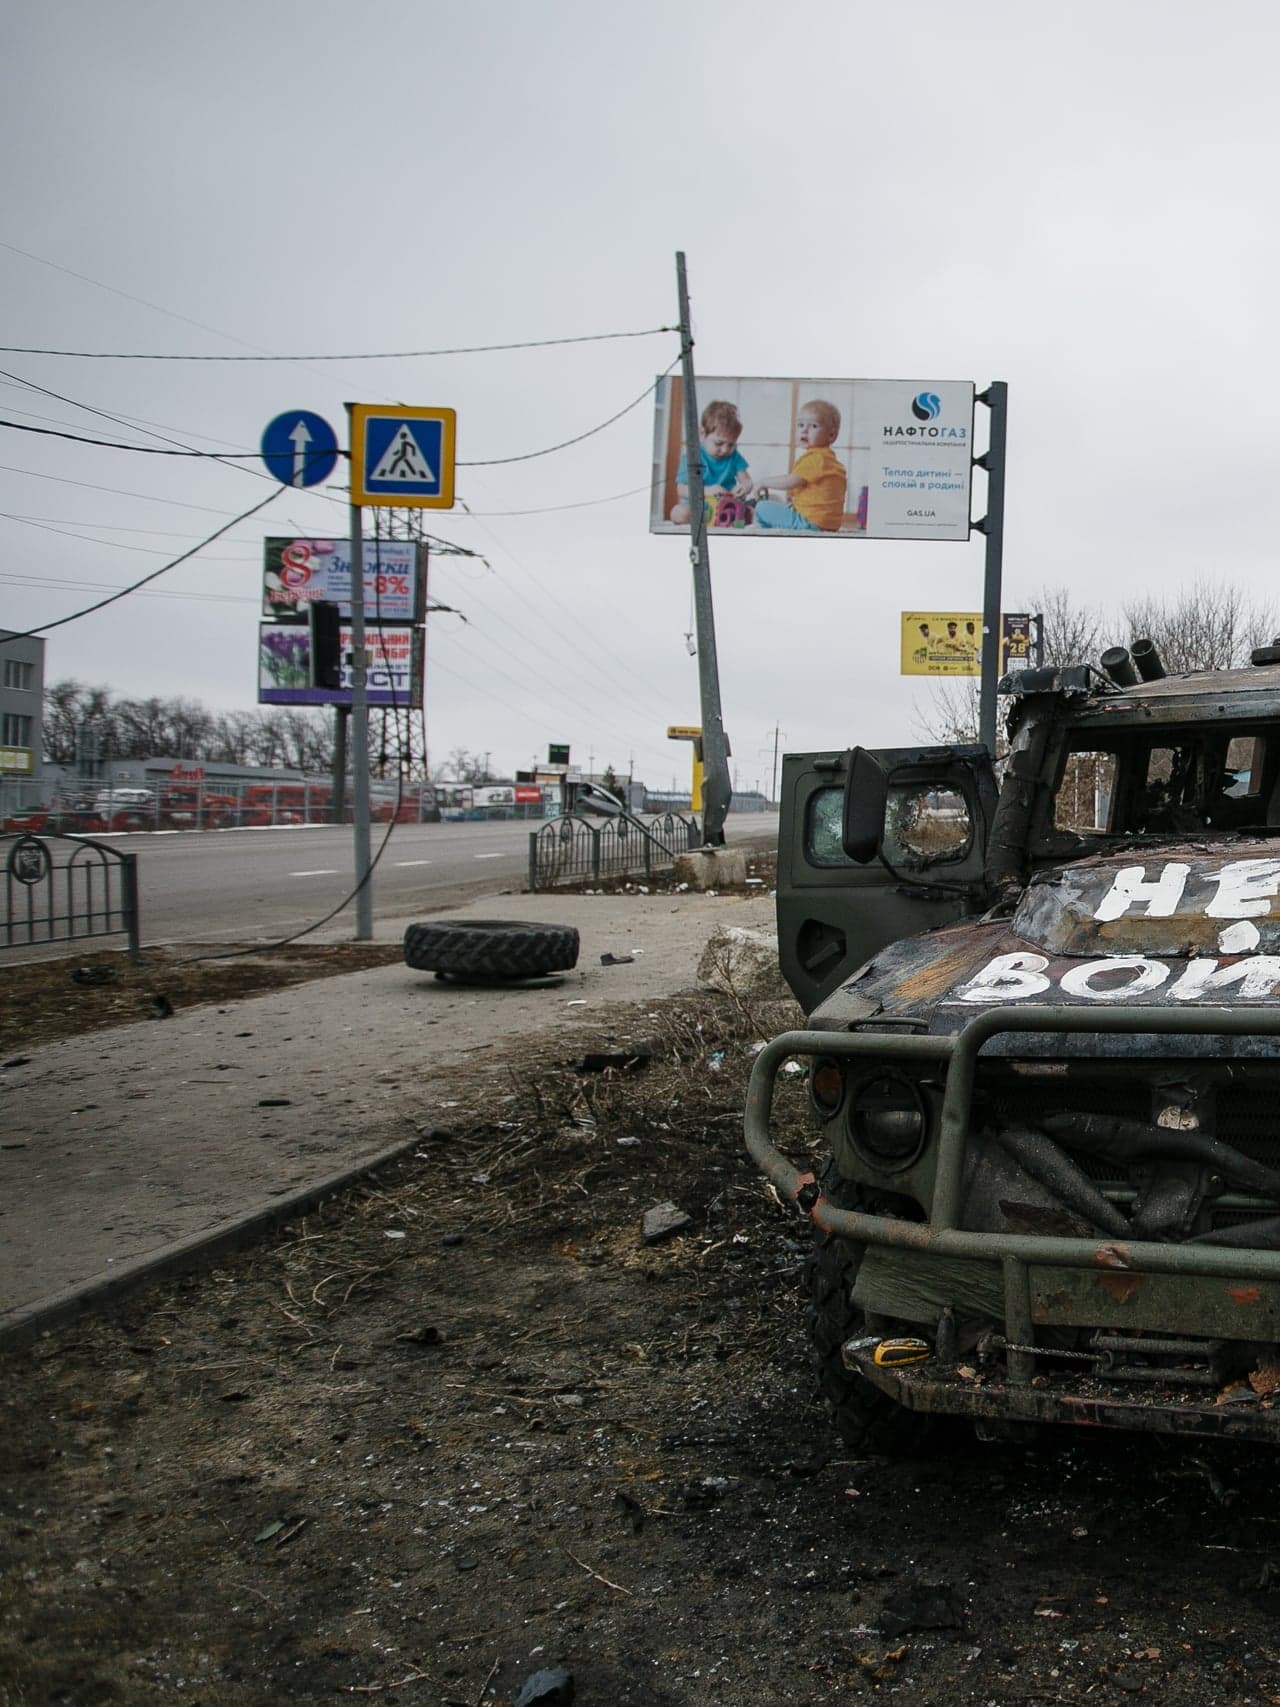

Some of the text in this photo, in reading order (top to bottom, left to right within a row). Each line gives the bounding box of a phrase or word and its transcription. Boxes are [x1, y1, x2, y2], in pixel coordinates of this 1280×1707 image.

[883, 426, 966, 438] НАФТОГАЗ
[883, 467, 914, 477] Тепло
[916, 469, 951, 478] дитині
[928, 482, 964, 490] родині
[280, 545, 312, 588] 8
[328, 556, 409, 574] Знжки
